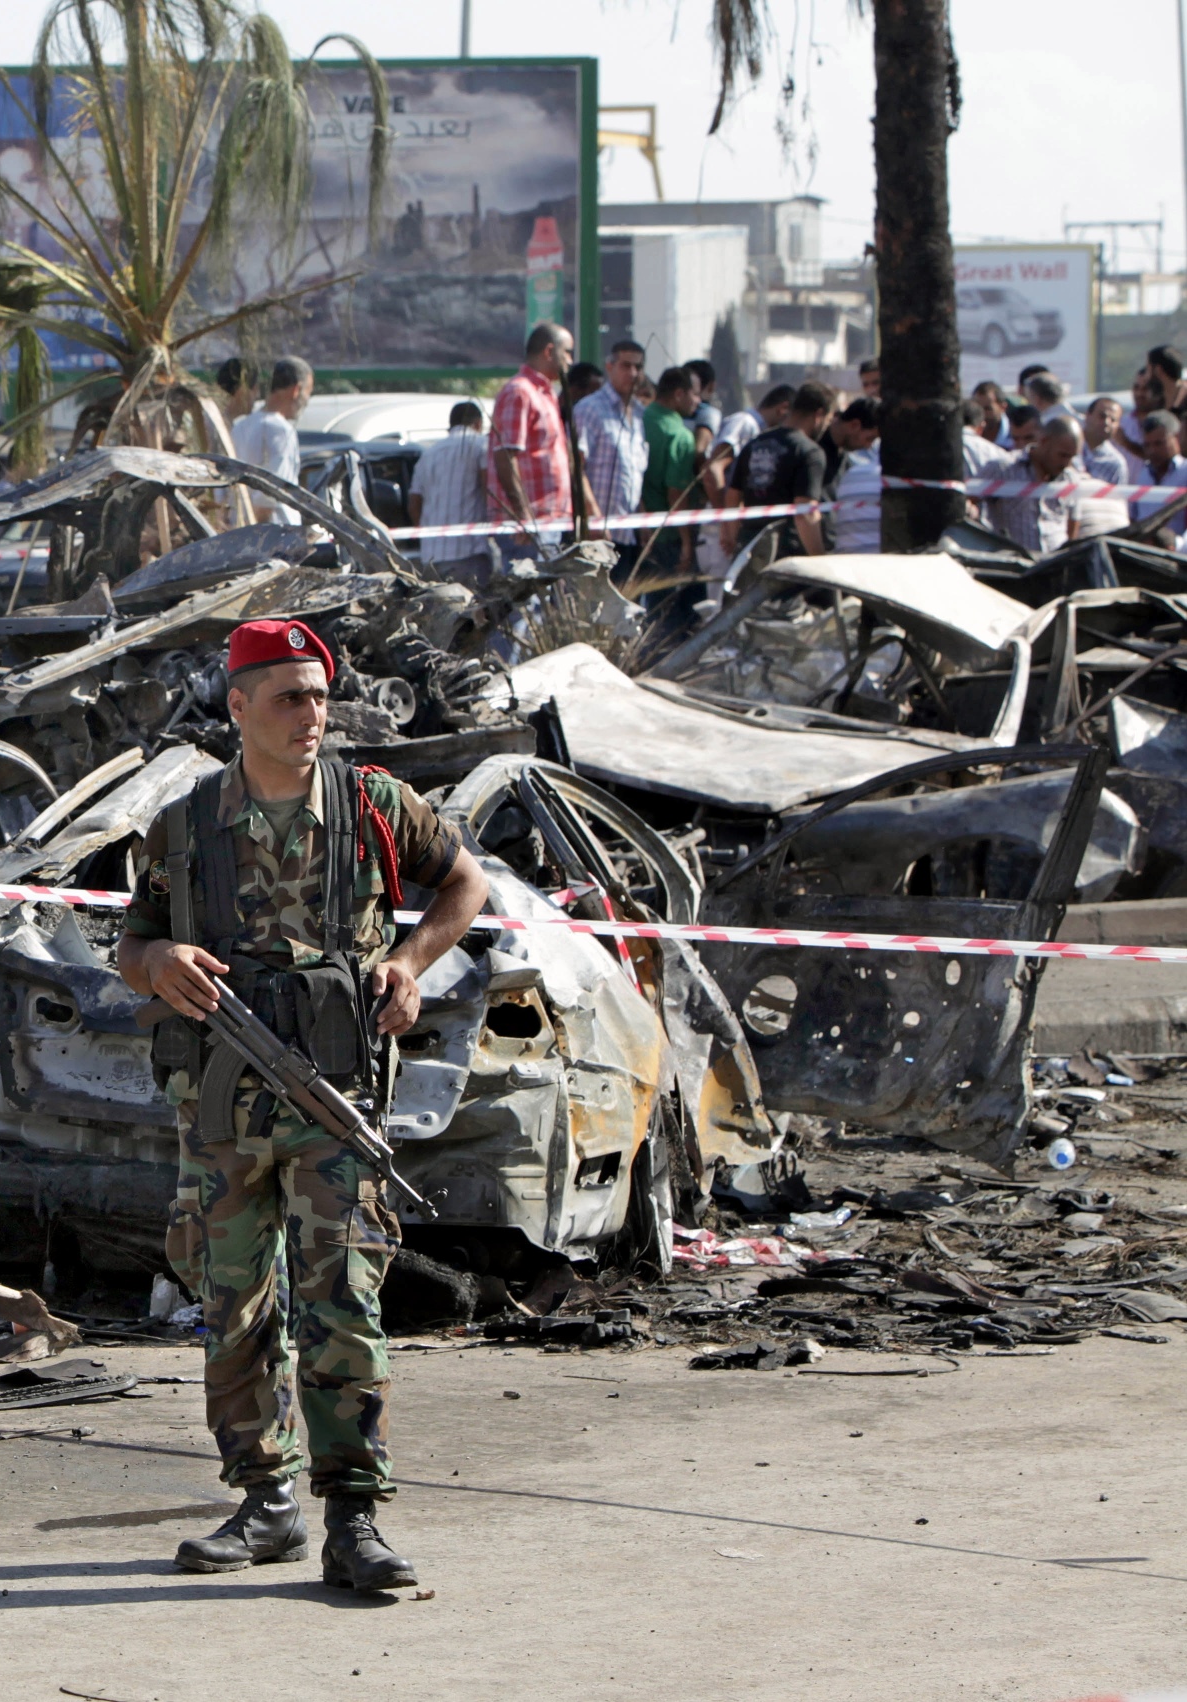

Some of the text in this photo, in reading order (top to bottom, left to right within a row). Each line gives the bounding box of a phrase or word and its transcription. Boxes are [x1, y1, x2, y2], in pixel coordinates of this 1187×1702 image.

[343, 95, 405, 114] VAE
[954, 261, 1069, 281] Great Wall
